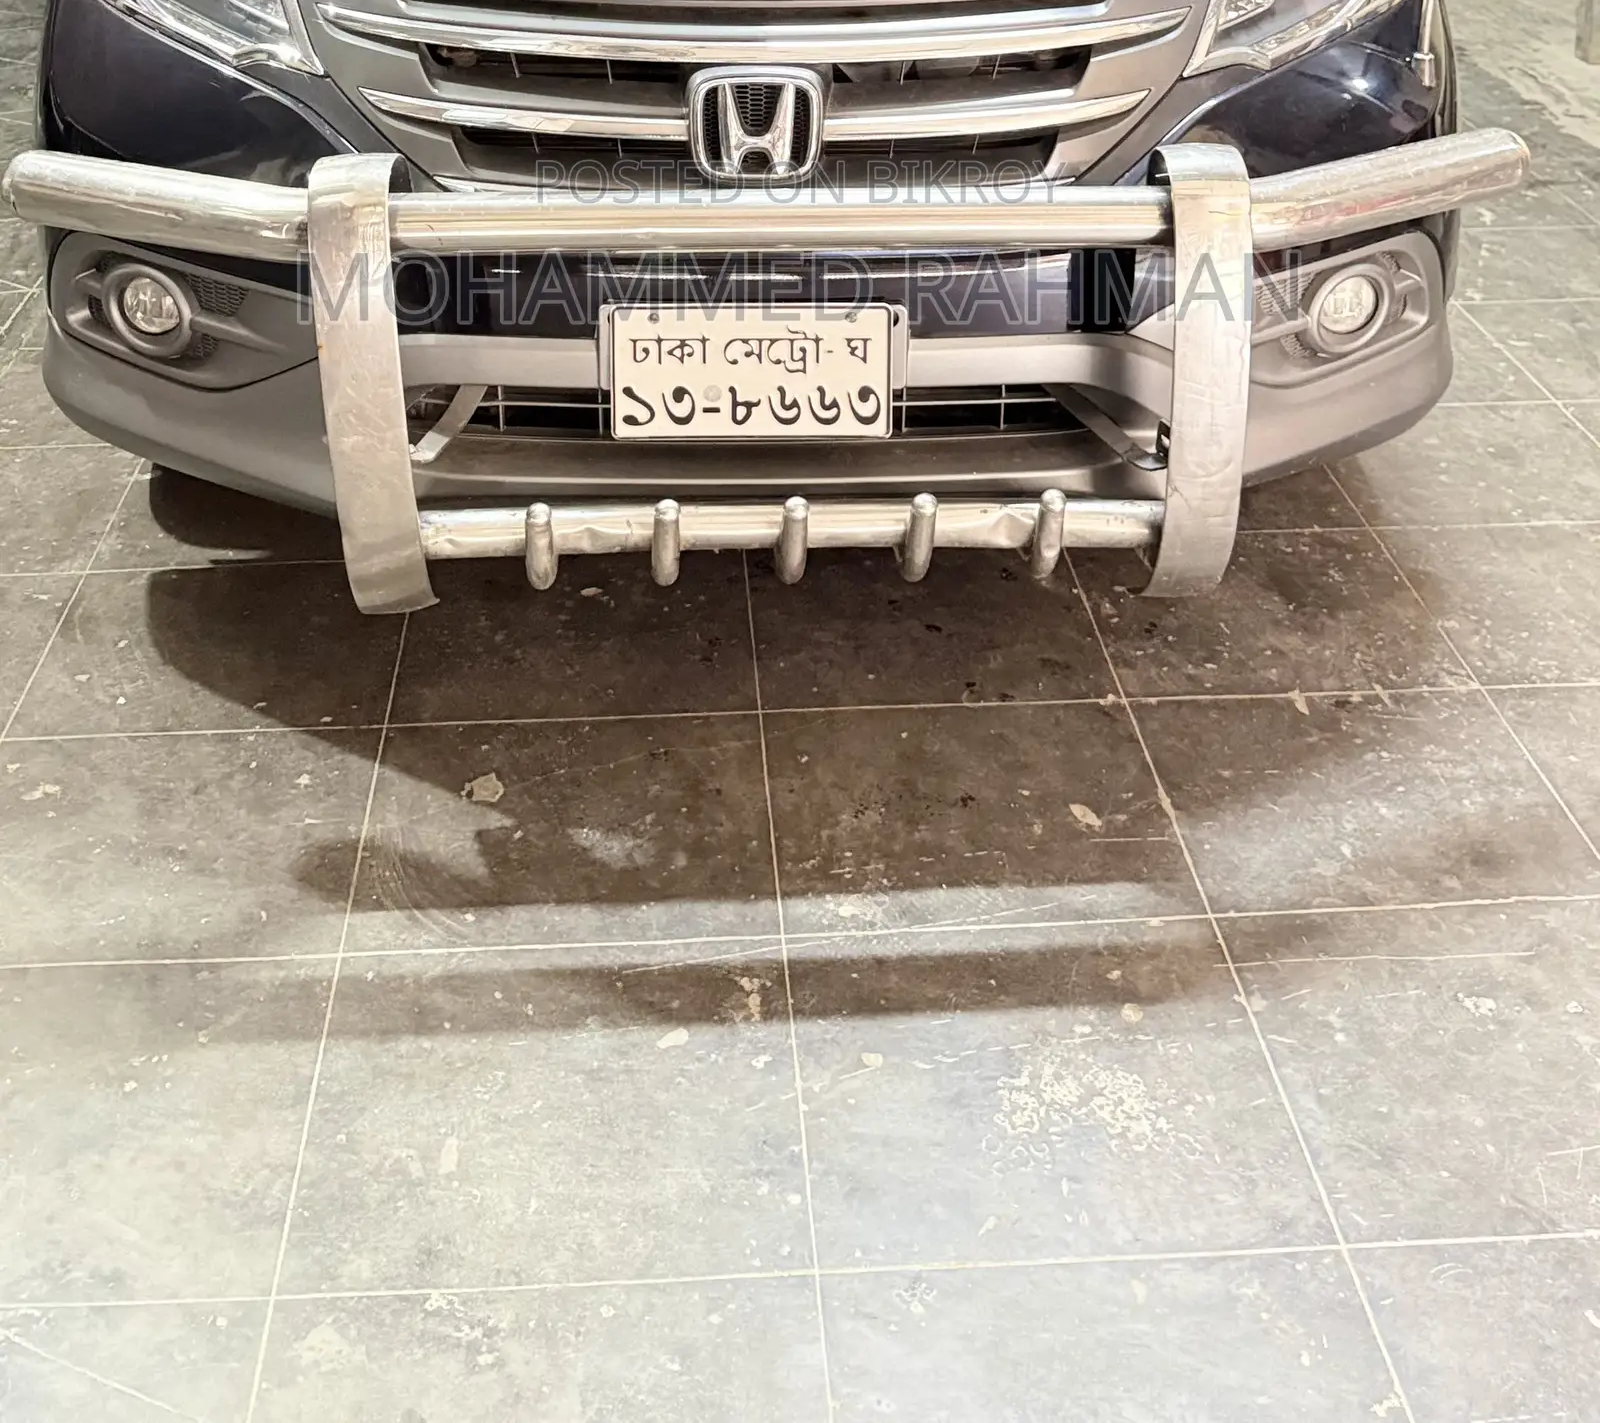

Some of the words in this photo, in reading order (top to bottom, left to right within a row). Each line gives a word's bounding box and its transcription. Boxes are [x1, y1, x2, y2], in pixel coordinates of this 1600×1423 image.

[629, 334, 710, 365] ঢাকা
[845, 336, 873, 365] ঘ
[621, 385, 882, 426] ১৩-৮৬৬৩
